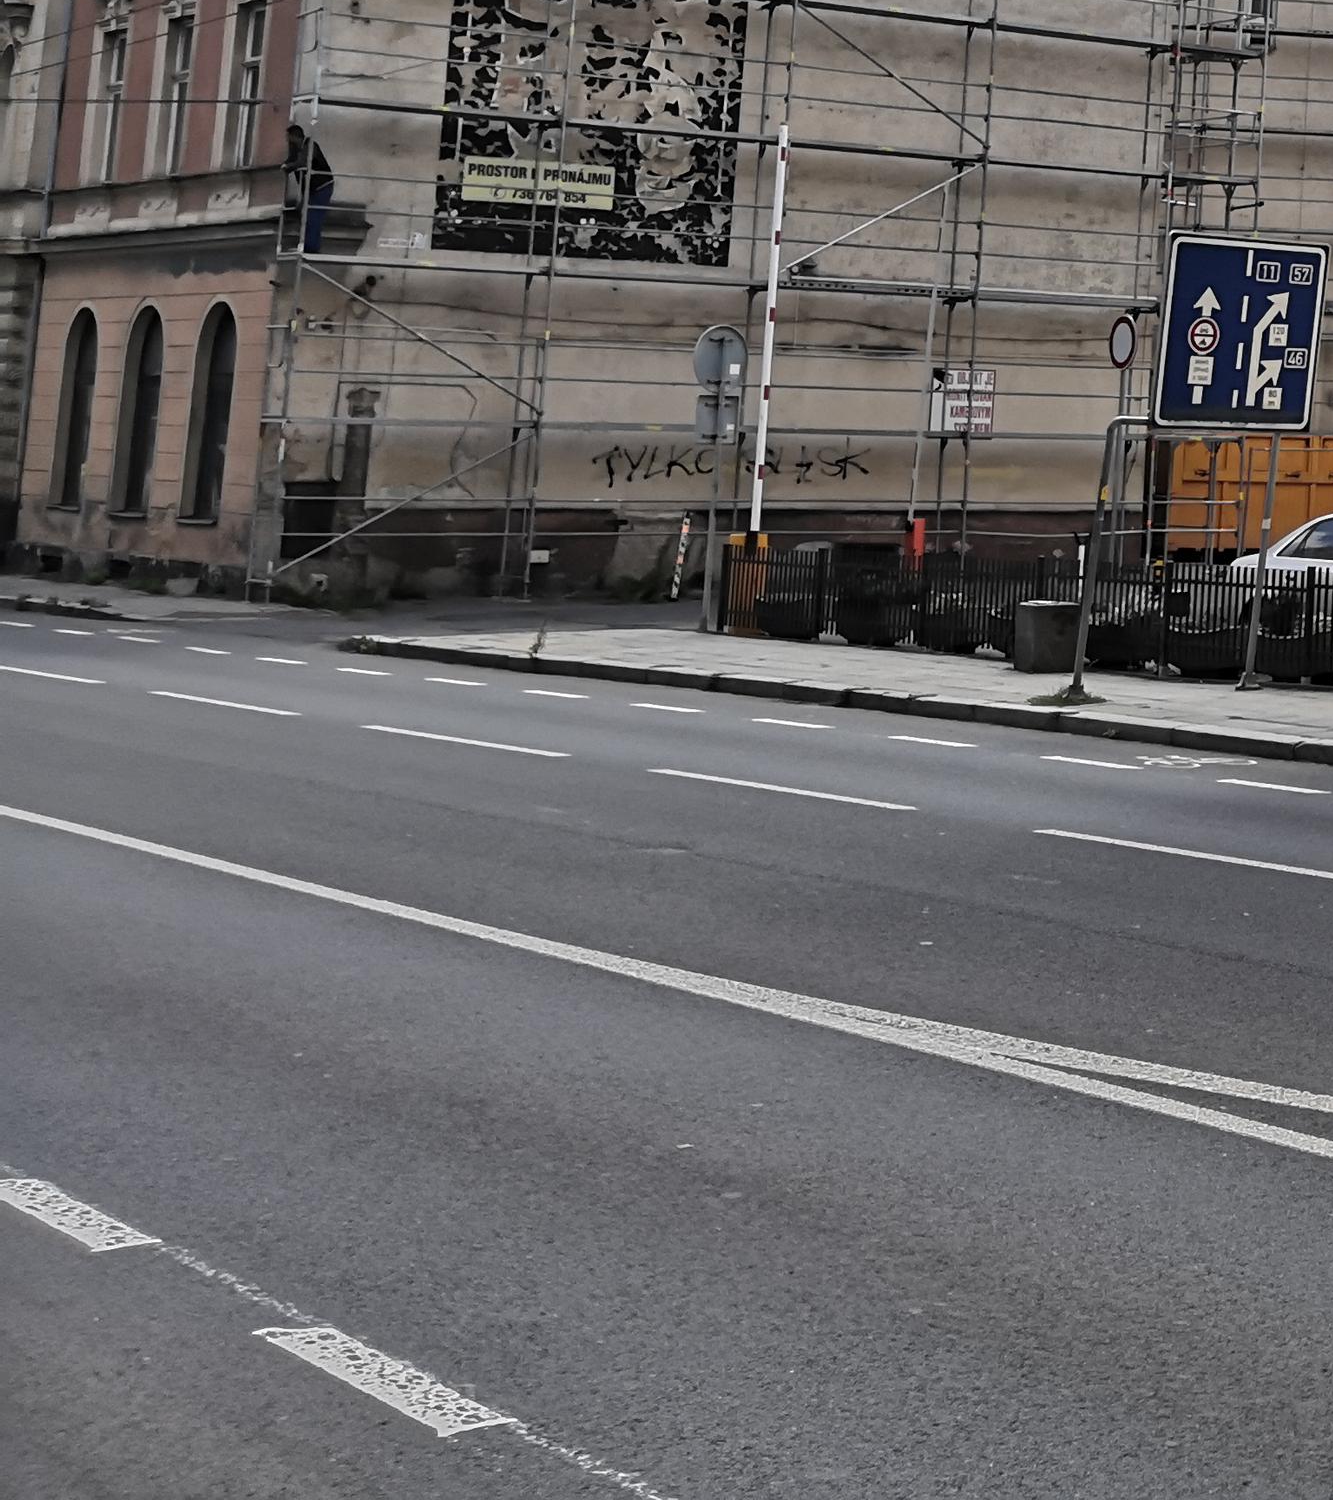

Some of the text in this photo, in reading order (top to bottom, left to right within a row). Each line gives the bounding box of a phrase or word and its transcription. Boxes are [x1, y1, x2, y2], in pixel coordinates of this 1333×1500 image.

[468, 163, 527, 179] PROSTOR
[543, 168, 611, 186] PRONÁJMU
[1262, 264, 1310, 281] 11 57
[1287, 351, 1304, 366] 46
